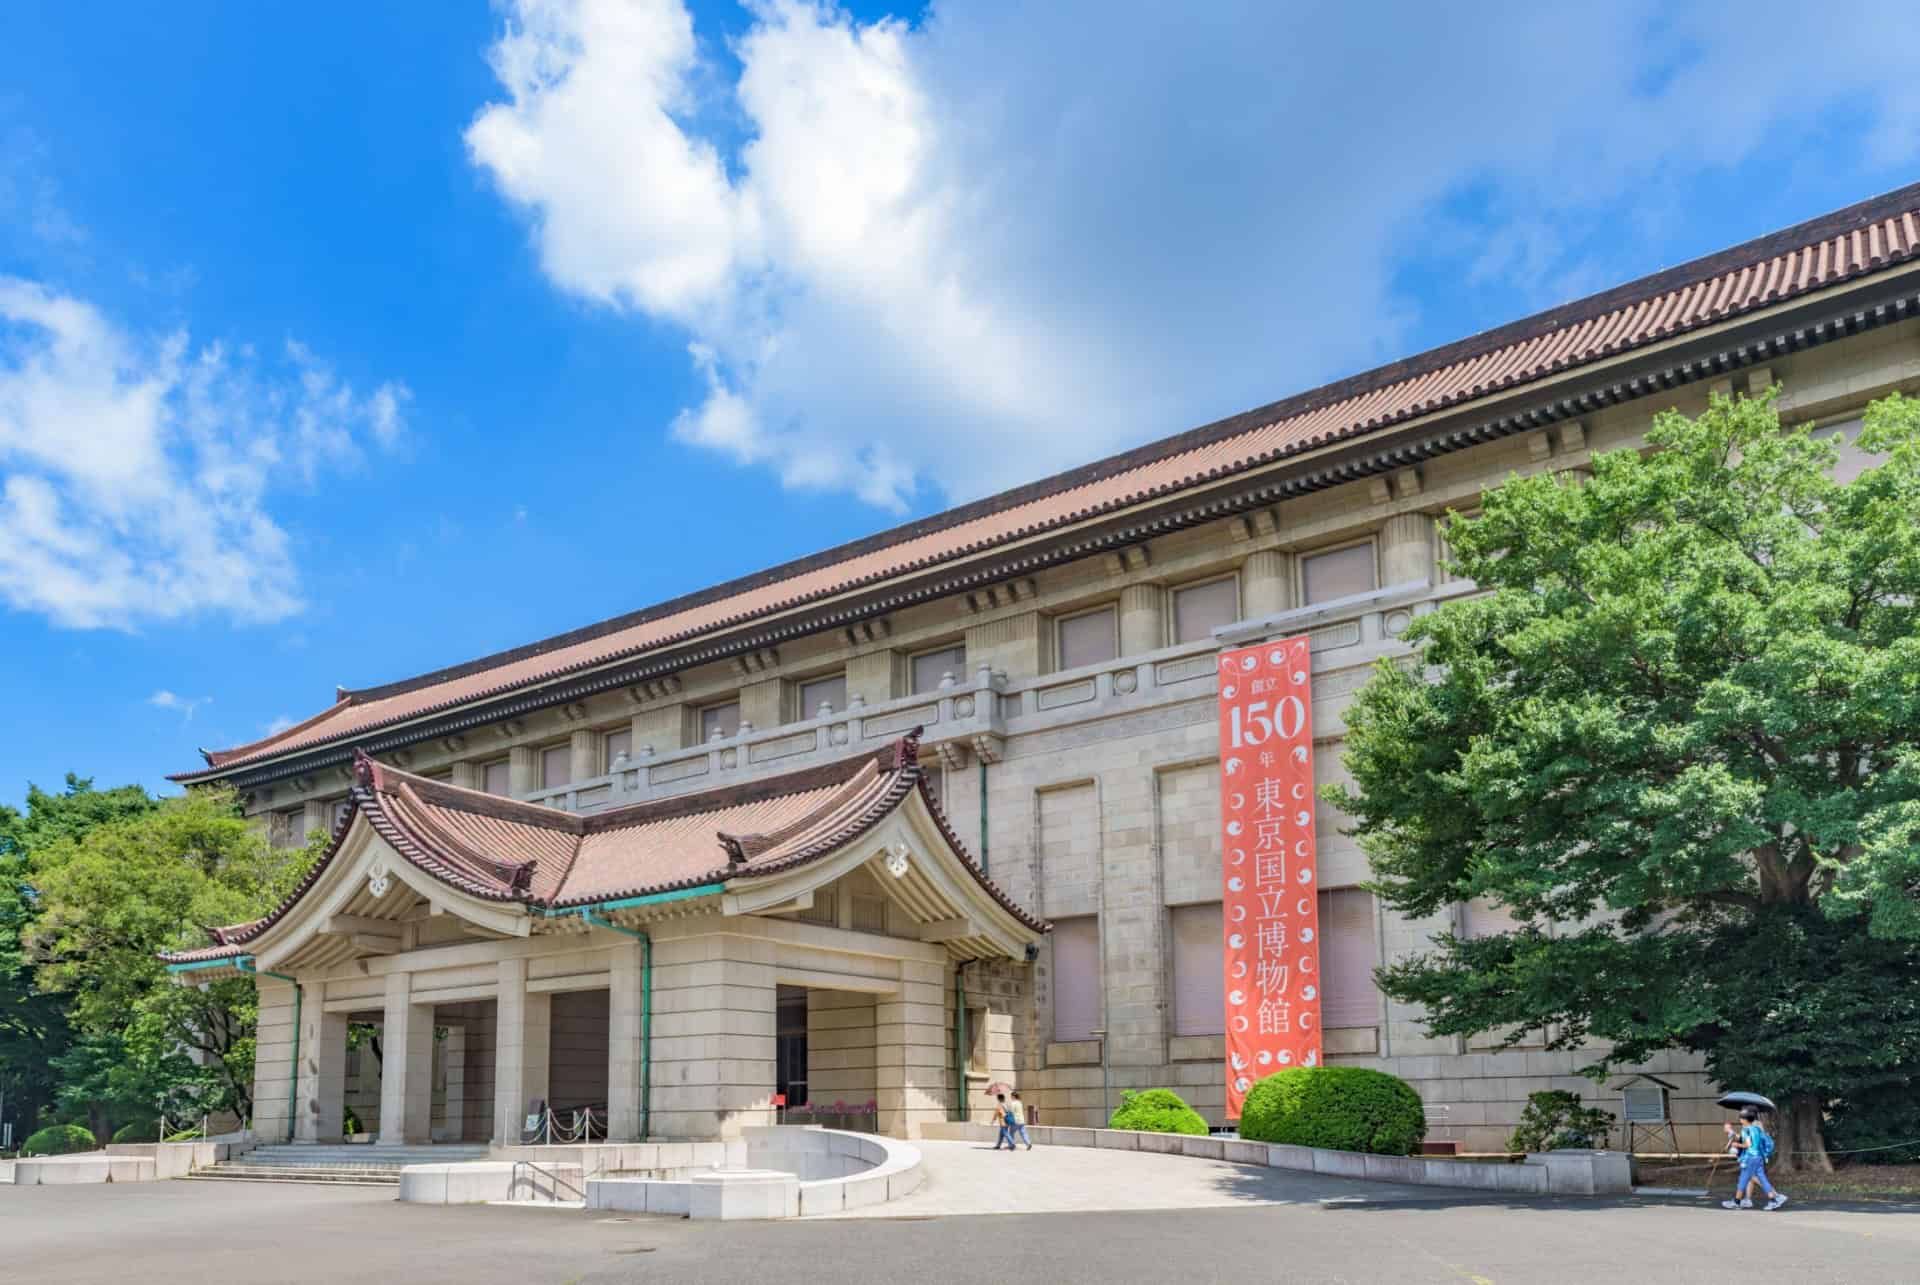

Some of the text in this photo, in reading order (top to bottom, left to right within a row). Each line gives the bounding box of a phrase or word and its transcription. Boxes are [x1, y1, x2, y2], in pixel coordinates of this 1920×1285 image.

[1231, 696, 1305, 748] 150
[1254, 778, 1289, 1035] 東京国立博物館
